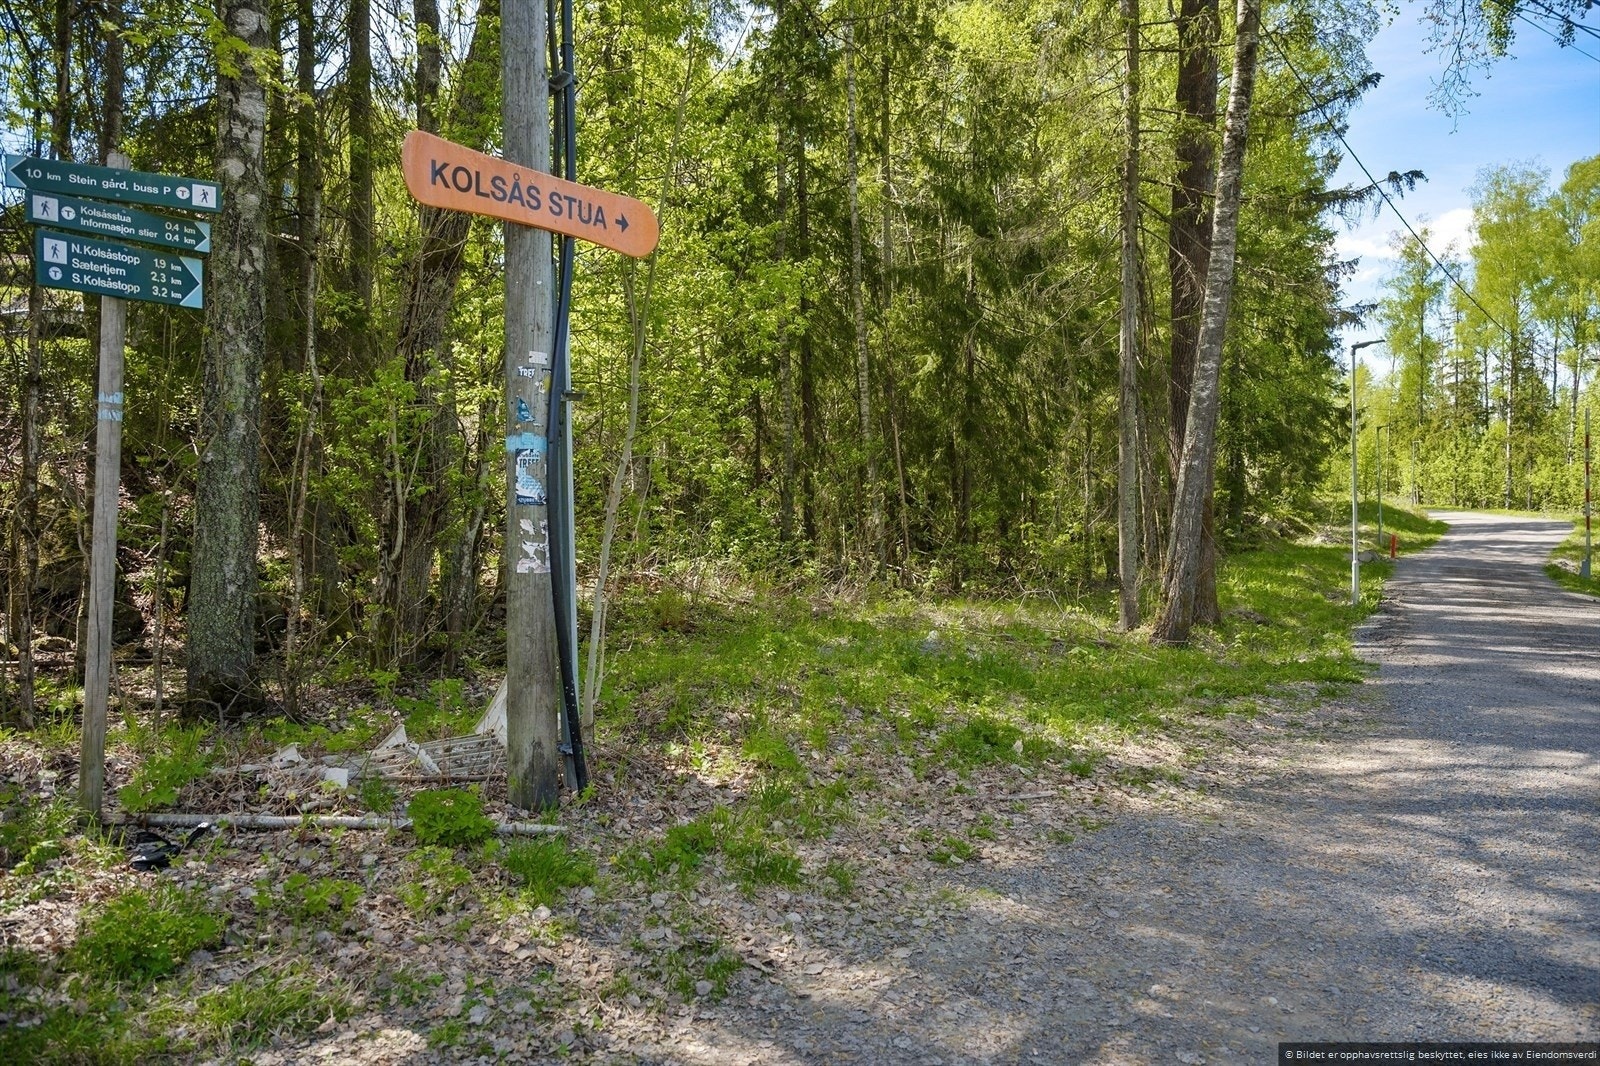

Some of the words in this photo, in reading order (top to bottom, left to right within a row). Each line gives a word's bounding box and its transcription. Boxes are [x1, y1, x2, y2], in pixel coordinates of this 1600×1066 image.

[47, 172, 61, 181] km
[69, 174, 97, 186] Stein
[133, 182, 159, 194] buss
[163, 186, 171, 195] P
[431, 159, 542, 211] KOLSÅS
[549, 191, 607, 230] STUA
[80, 206, 132, 223] Kolsåsstua
[184, 226, 196, 235] km
[80, 217, 135, 234] Informasjon
[138, 228, 159, 239] stier
[184, 236, 196, 245] km
[71, 257, 126, 276] Sætertjern
[170, 277, 182, 286] km
[170, 263, 182, 272] km
[170, 291, 182, 299] km
